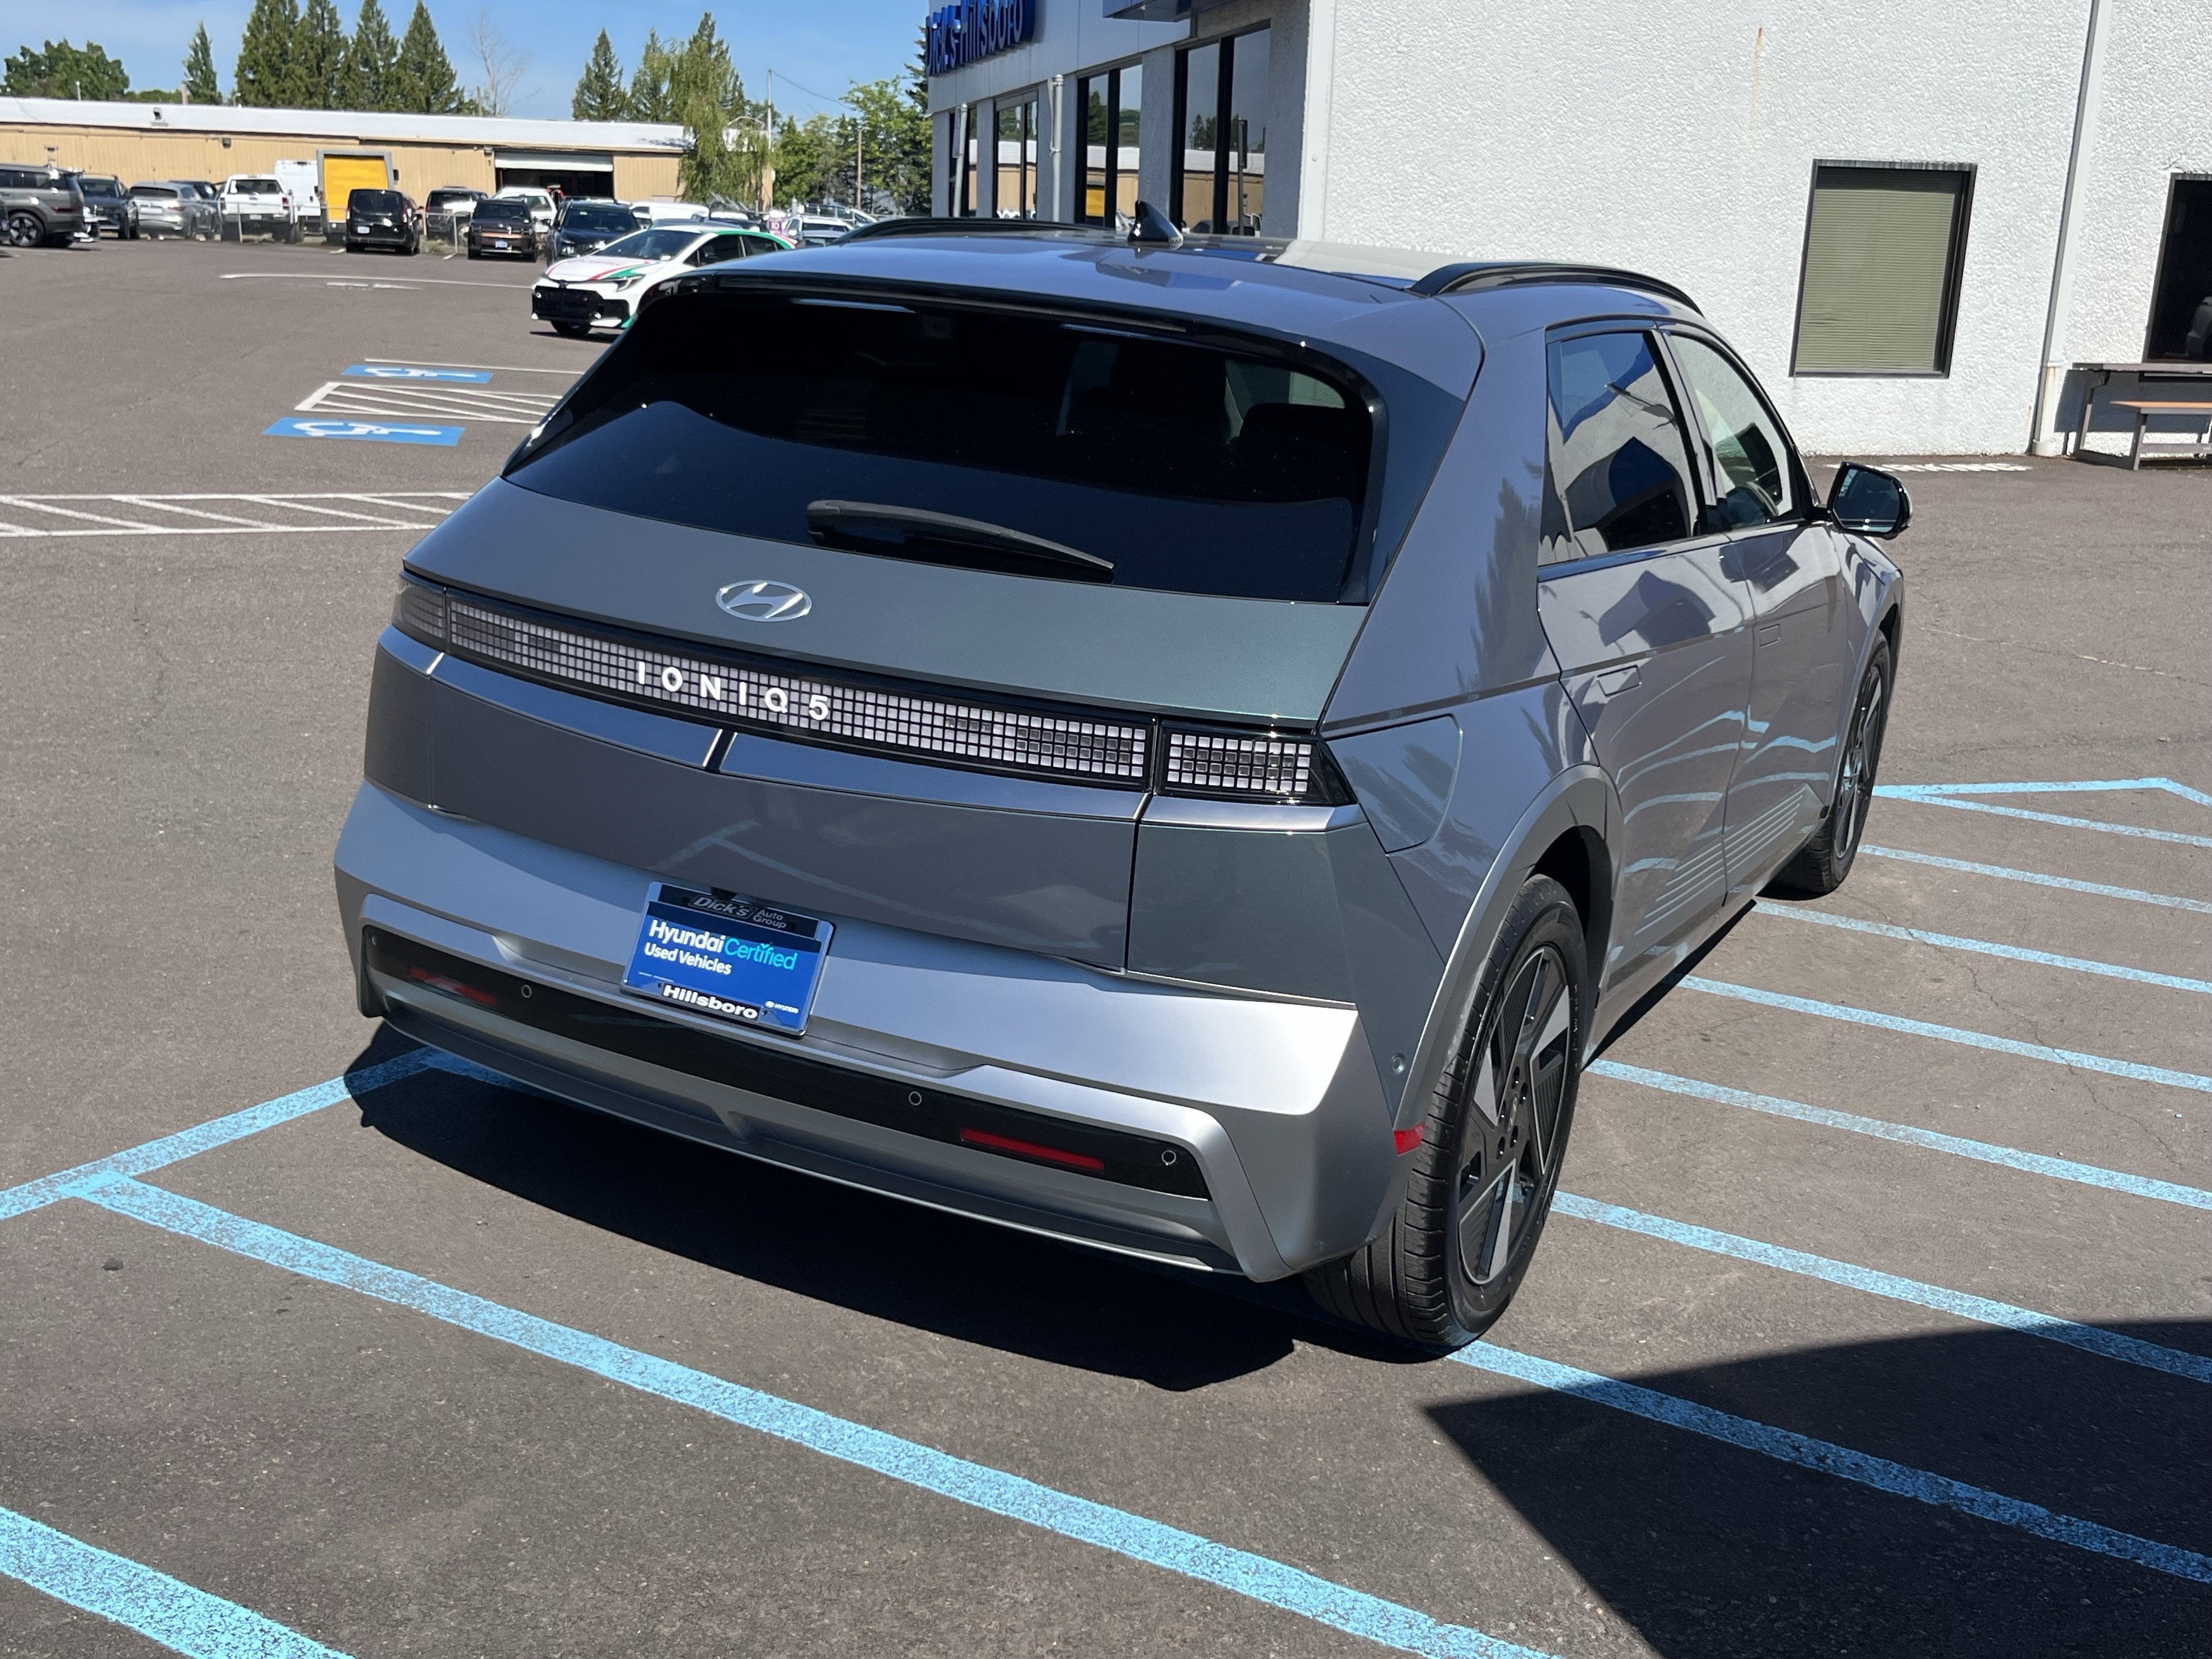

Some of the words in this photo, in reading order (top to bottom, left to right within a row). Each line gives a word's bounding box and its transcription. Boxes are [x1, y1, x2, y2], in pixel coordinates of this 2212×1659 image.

[638, 662, 788, 713] IONIQ
[809, 695, 829, 721] 5
[693, 896, 750, 916] Dick's
[757, 909, 784, 921] Auto
[753, 915, 787, 929] Group
[644, 942, 679, 962] Used
[679, 950, 732, 975] Vehicles
[663, 985, 758, 1019] Hillsboro
